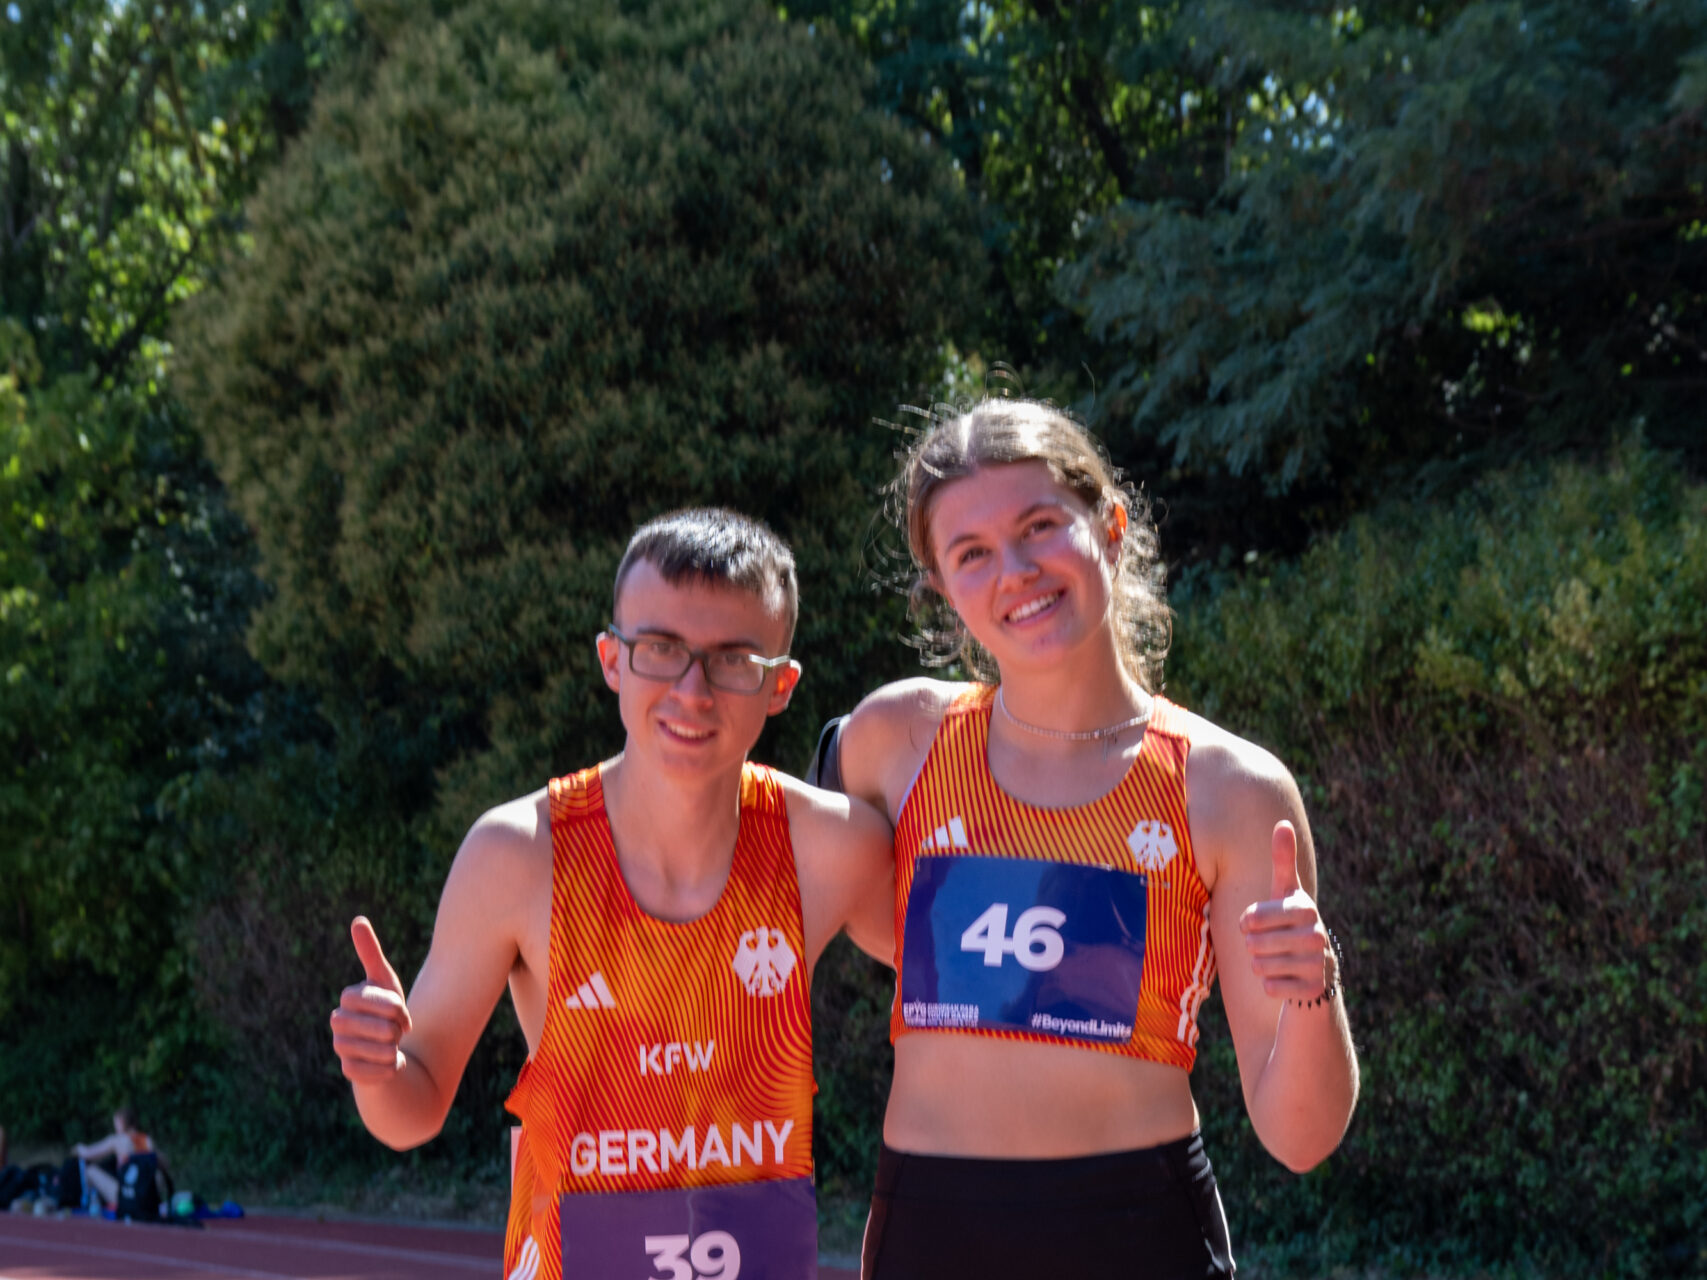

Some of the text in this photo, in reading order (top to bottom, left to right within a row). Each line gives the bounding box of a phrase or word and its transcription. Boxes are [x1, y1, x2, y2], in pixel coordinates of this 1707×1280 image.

[961, 903, 1067, 971] 46
[1031, 1013, 1132, 1038] #BeyondLimits
[639, 1040, 715, 1075] KFW
[570, 1120, 794, 1176] GERMANY
